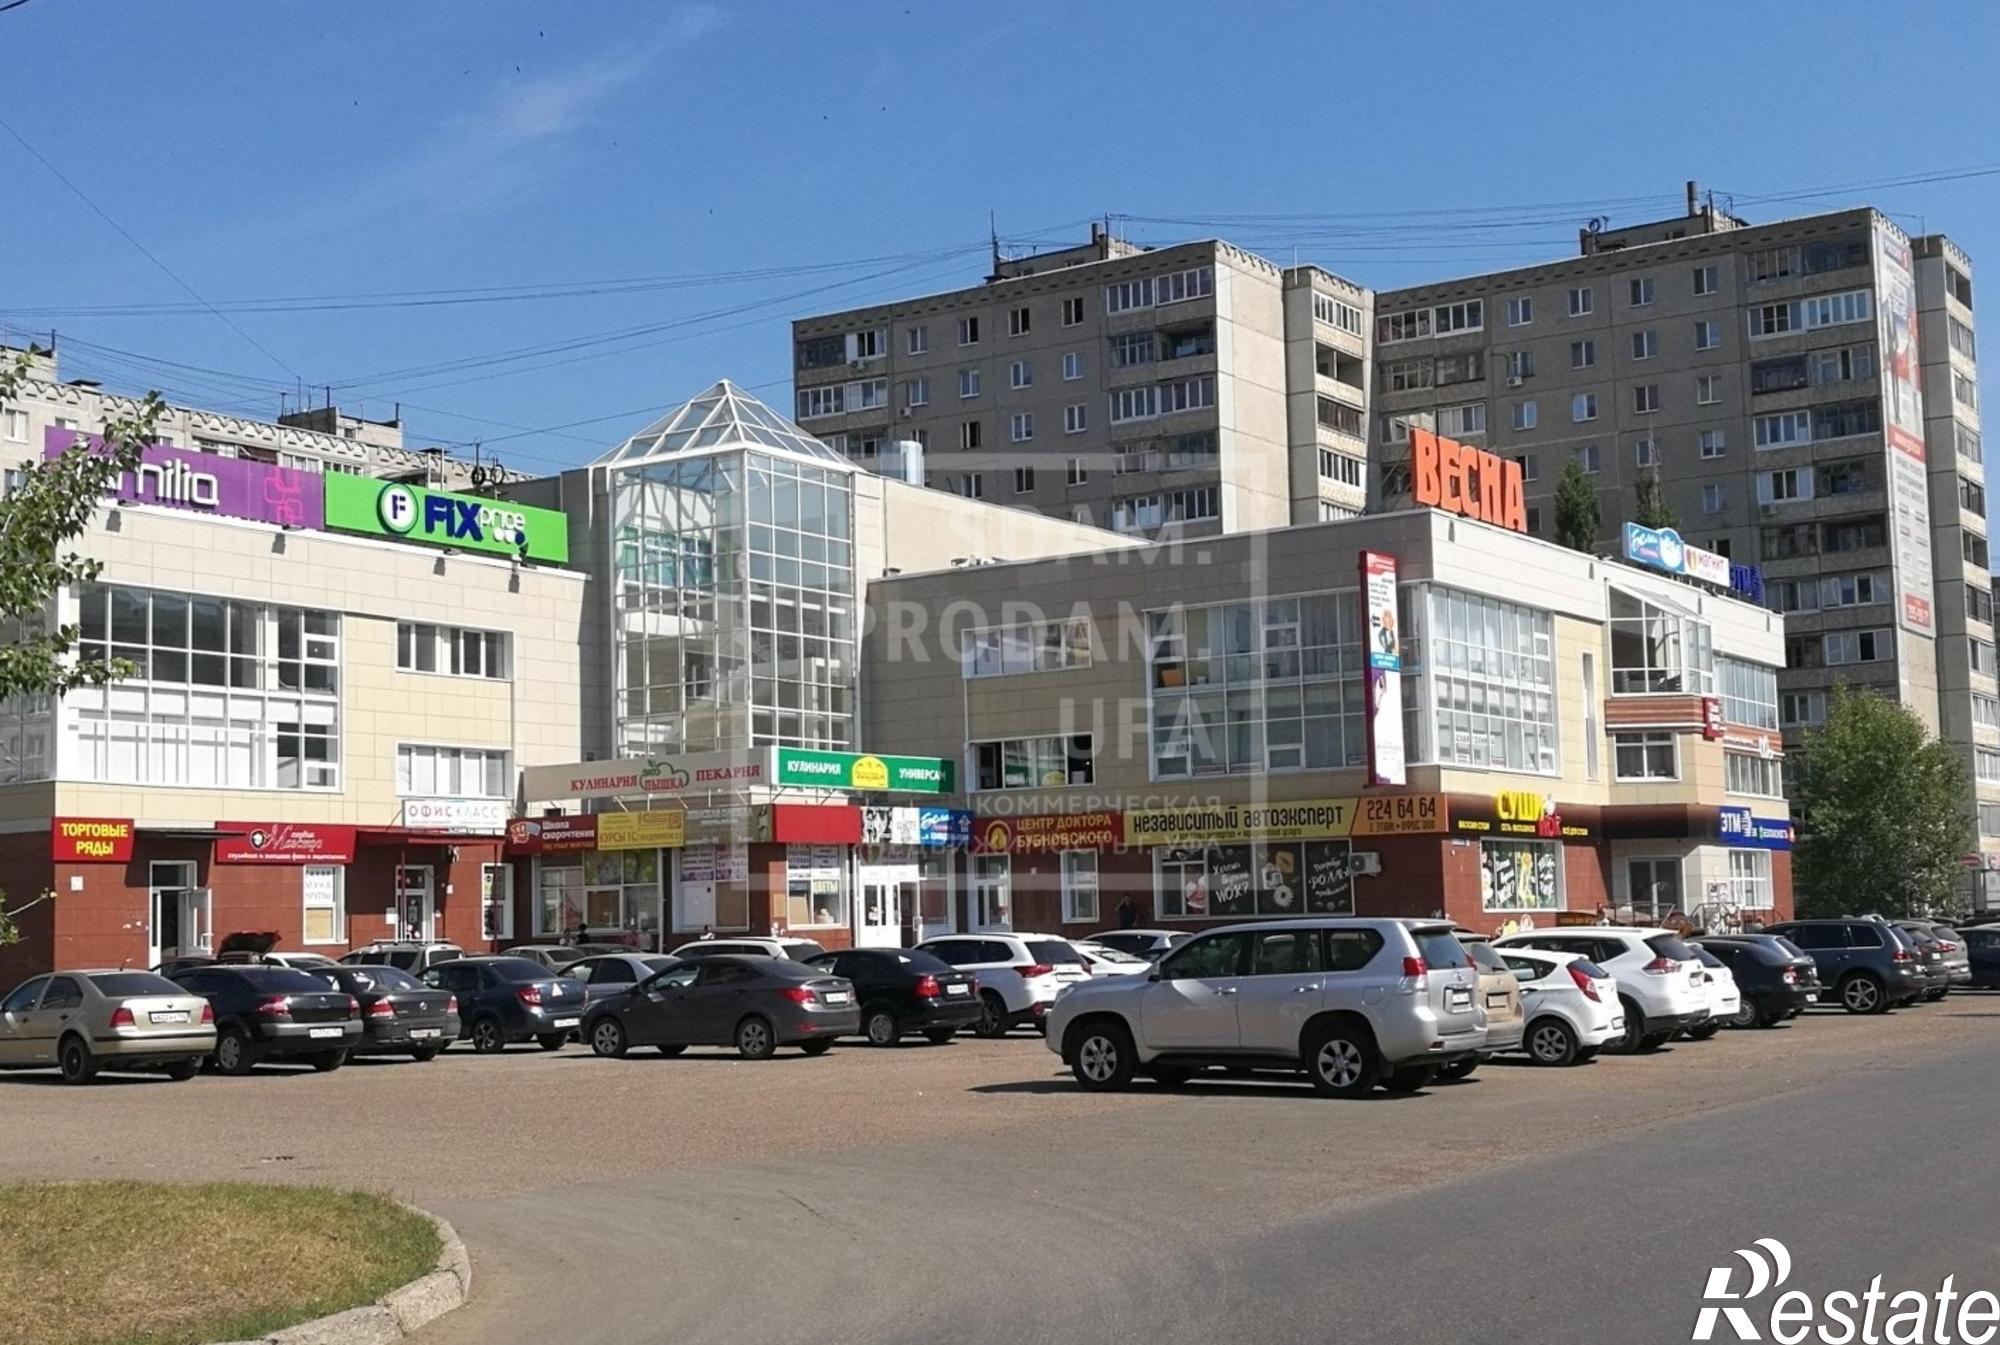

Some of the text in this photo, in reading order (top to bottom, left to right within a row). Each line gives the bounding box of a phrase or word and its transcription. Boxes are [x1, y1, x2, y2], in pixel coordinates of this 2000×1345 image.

[1411, 428, 1527, 533] ВЕСНА
[696, 765, 761, 782] ПЕКАРНЯ
[787, 760, 842, 775] КУЛИНАРИЯ
[1367, 796, 1436, 820] 224 64 64
[1497, 789, 1545, 822] СУШИ
[541, 820, 570, 831] Школа
[1017, 815, 1112, 832] ЦЕНТР ДОКТОРА
[1244, 806, 1343, 829] автоэксперт
[1721, 812, 1742, 833] ЭТМ
[61, 823, 129, 837] ТОРГОВЫЕ
[542, 830, 595, 842] скорочтения
[75, 840, 114, 856] РЯДЫ
[1017, 831, 1112, 848] БУБНОВСКОГО
